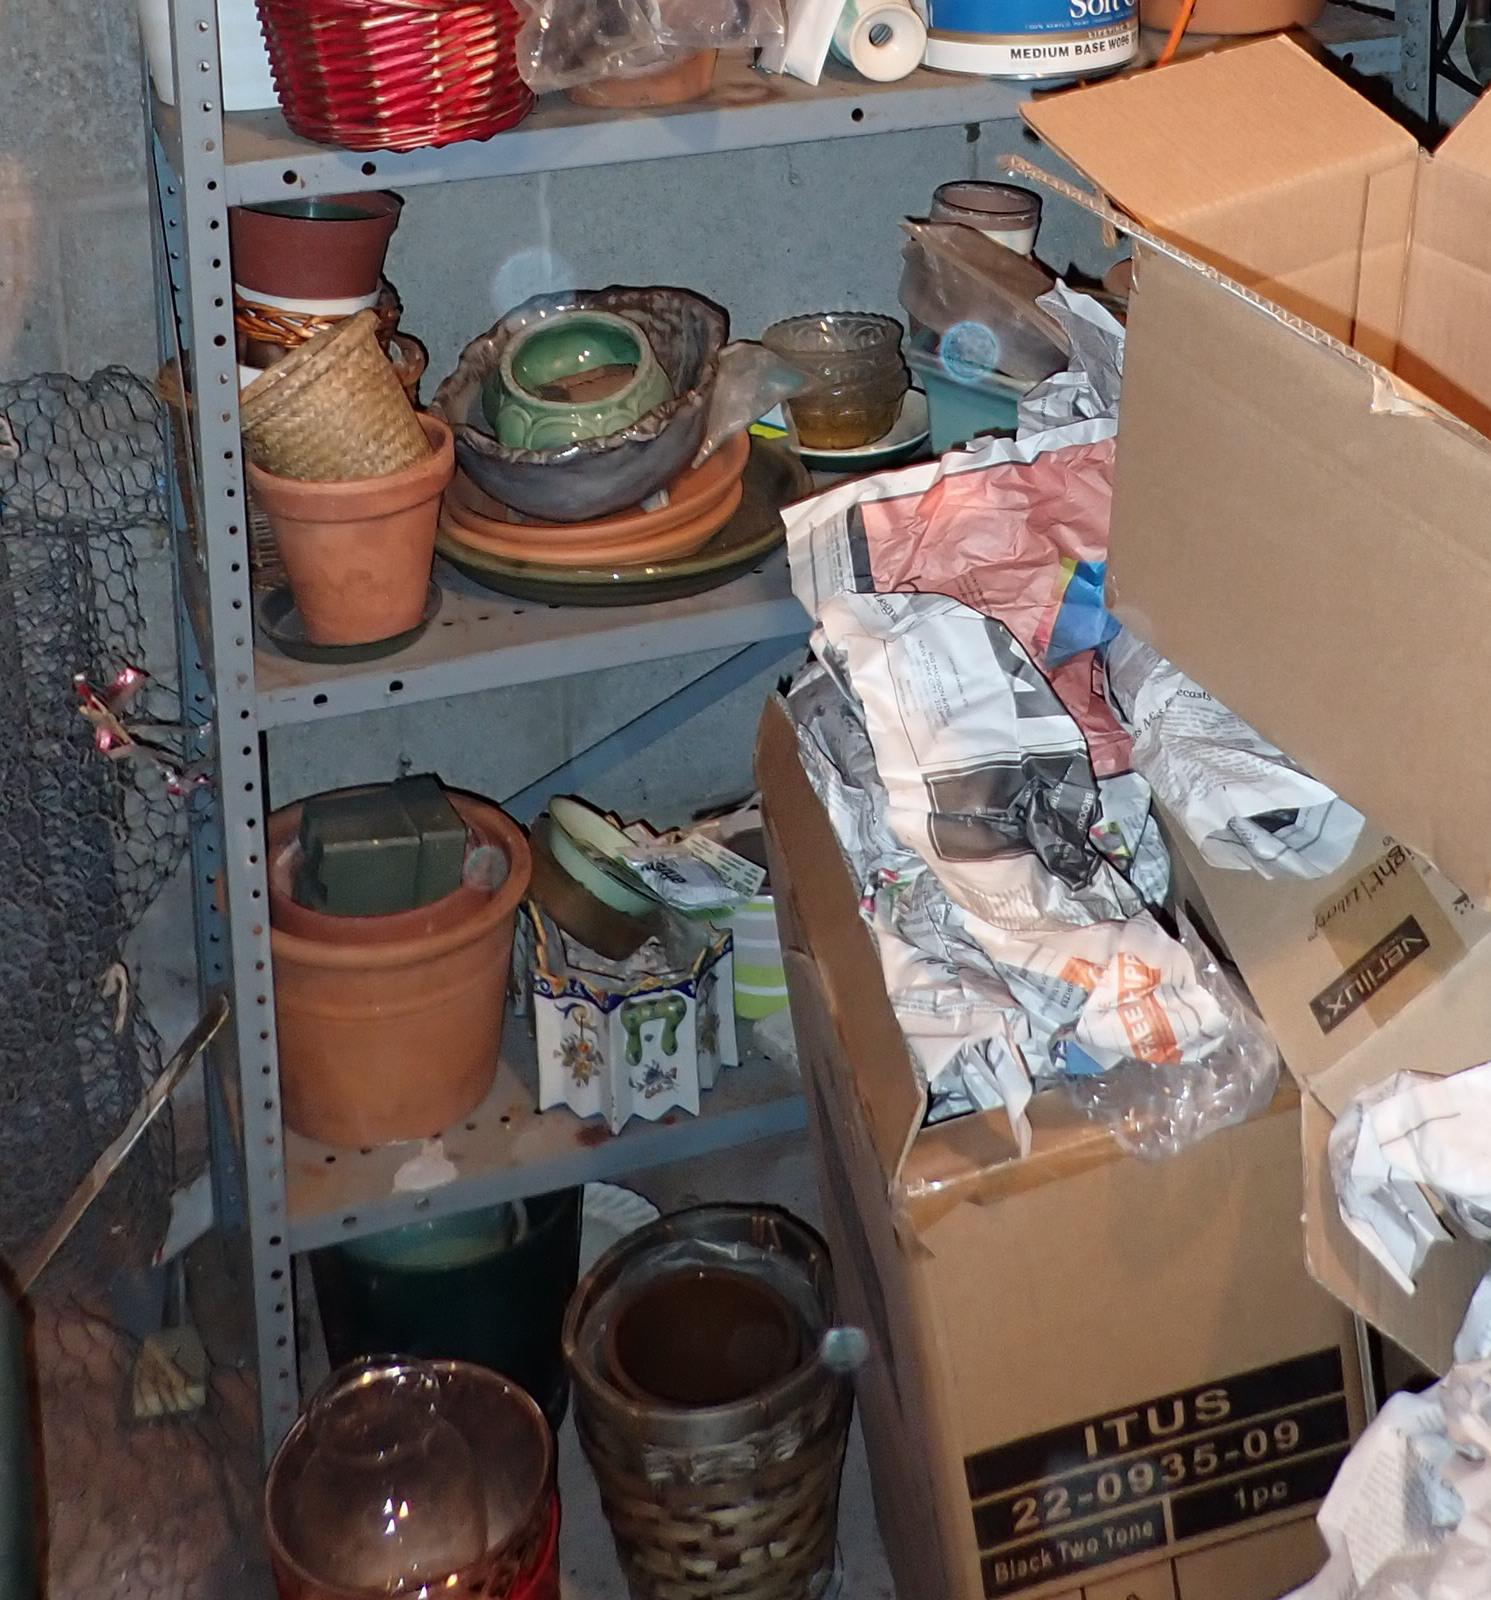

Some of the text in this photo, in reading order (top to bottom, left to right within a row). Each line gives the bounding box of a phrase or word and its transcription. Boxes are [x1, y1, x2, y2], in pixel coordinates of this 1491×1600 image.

[1010, 46, 1069, 60] MEDIUM
[1074, 41, 1106, 56] BASE
[1122, 1005, 1154, 1060] FREE
[1084, 1388, 1231, 1458] ITUS
[1011, 1418, 1300, 1533] 22-0935-09
[994, 1478, 1289, 1584] Black Two Tone 1pc
